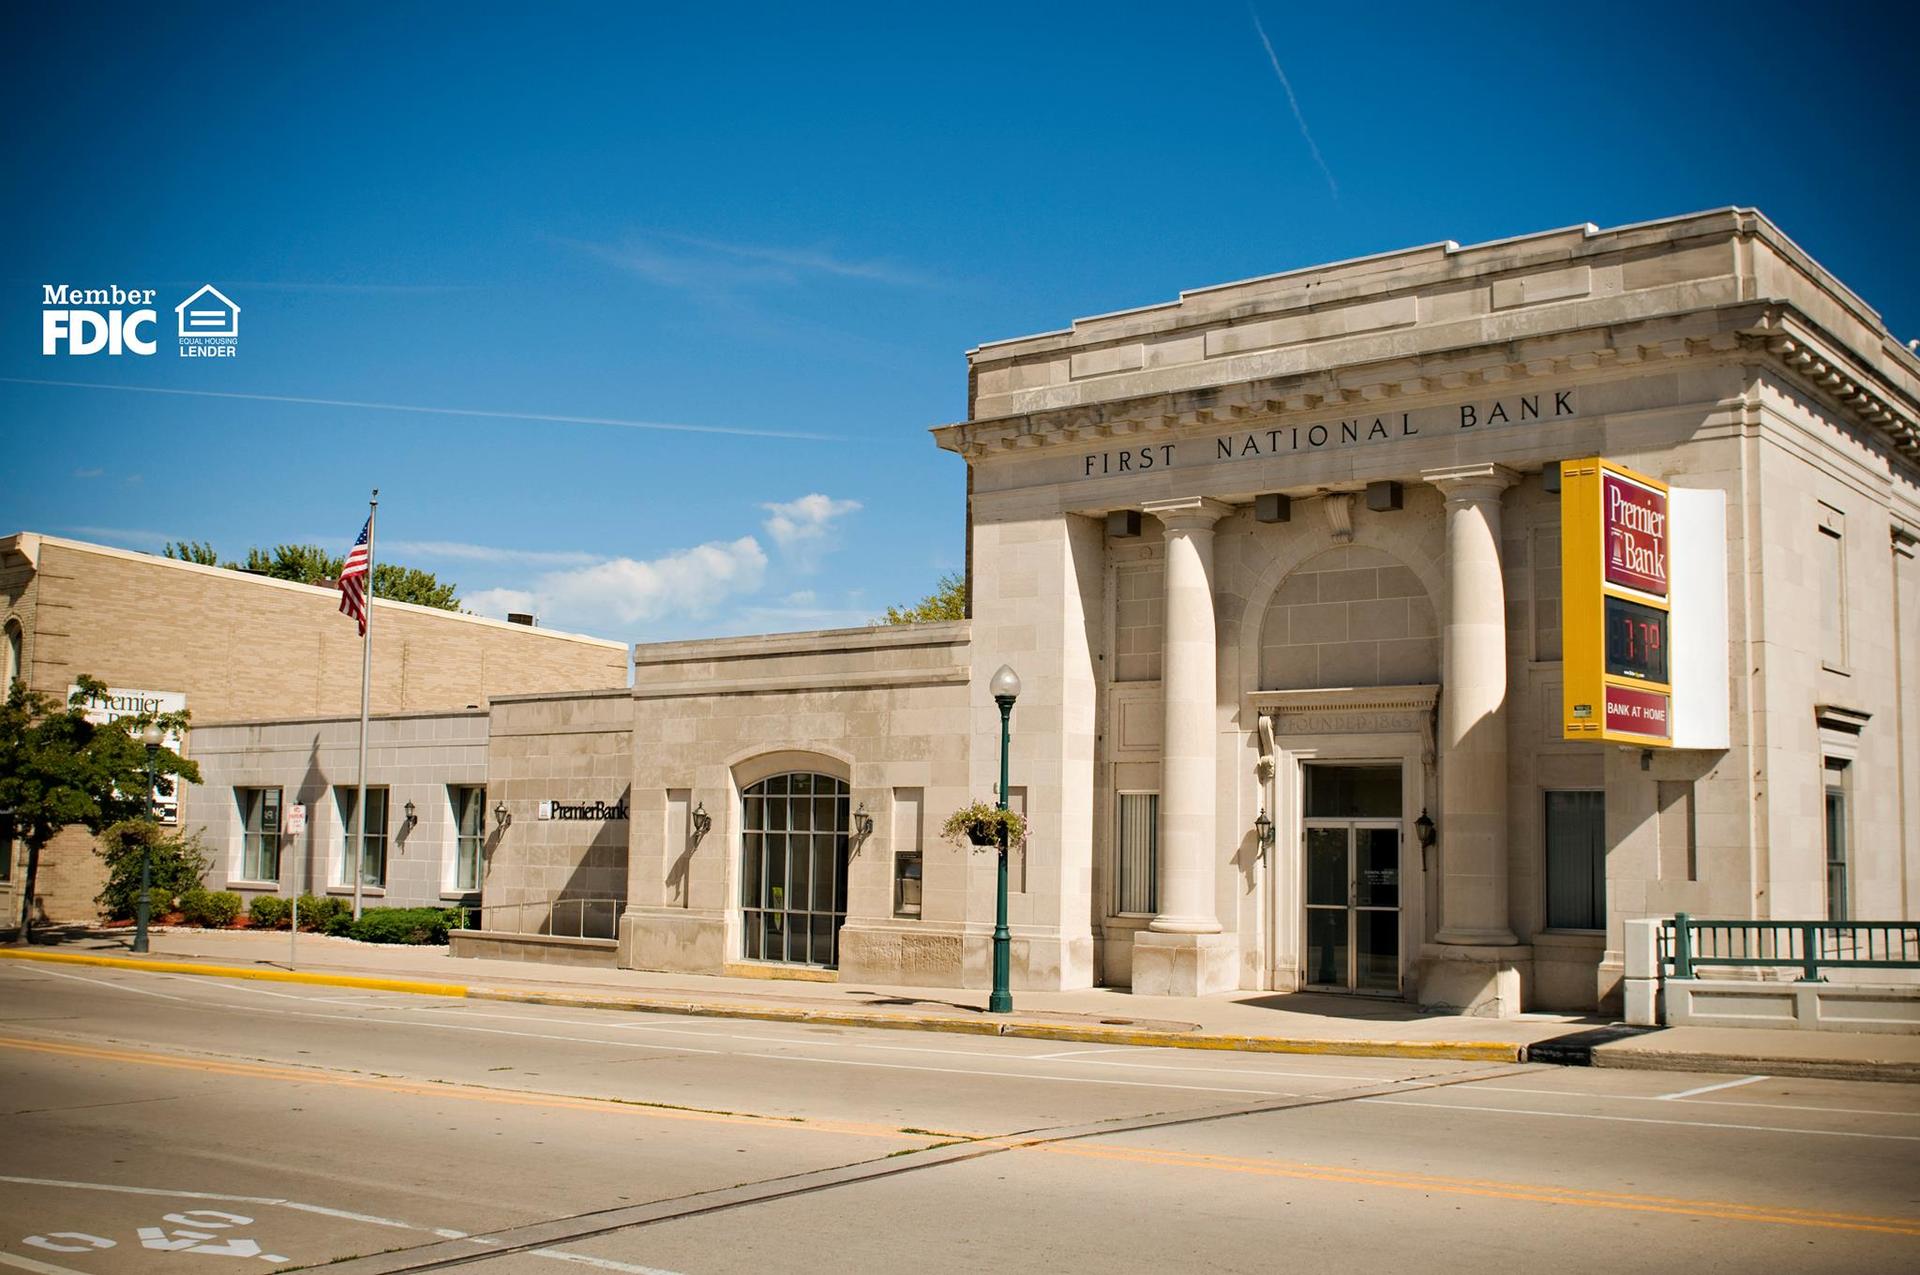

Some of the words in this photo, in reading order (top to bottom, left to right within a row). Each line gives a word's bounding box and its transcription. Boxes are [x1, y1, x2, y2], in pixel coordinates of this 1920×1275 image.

[1085, 444, 1176, 476] FIRST
[1216, 412, 1419, 459] NATIONAL
[1460, 391, 1574, 428] BANK
[1609, 484, 1665, 538] Premier
[1623, 532, 1666, 578] Bank
[1607, 702, 1630, 717] BANK
[1631, 706, 1642, 718] AT
[1643, 708, 1666, 722] HOME
